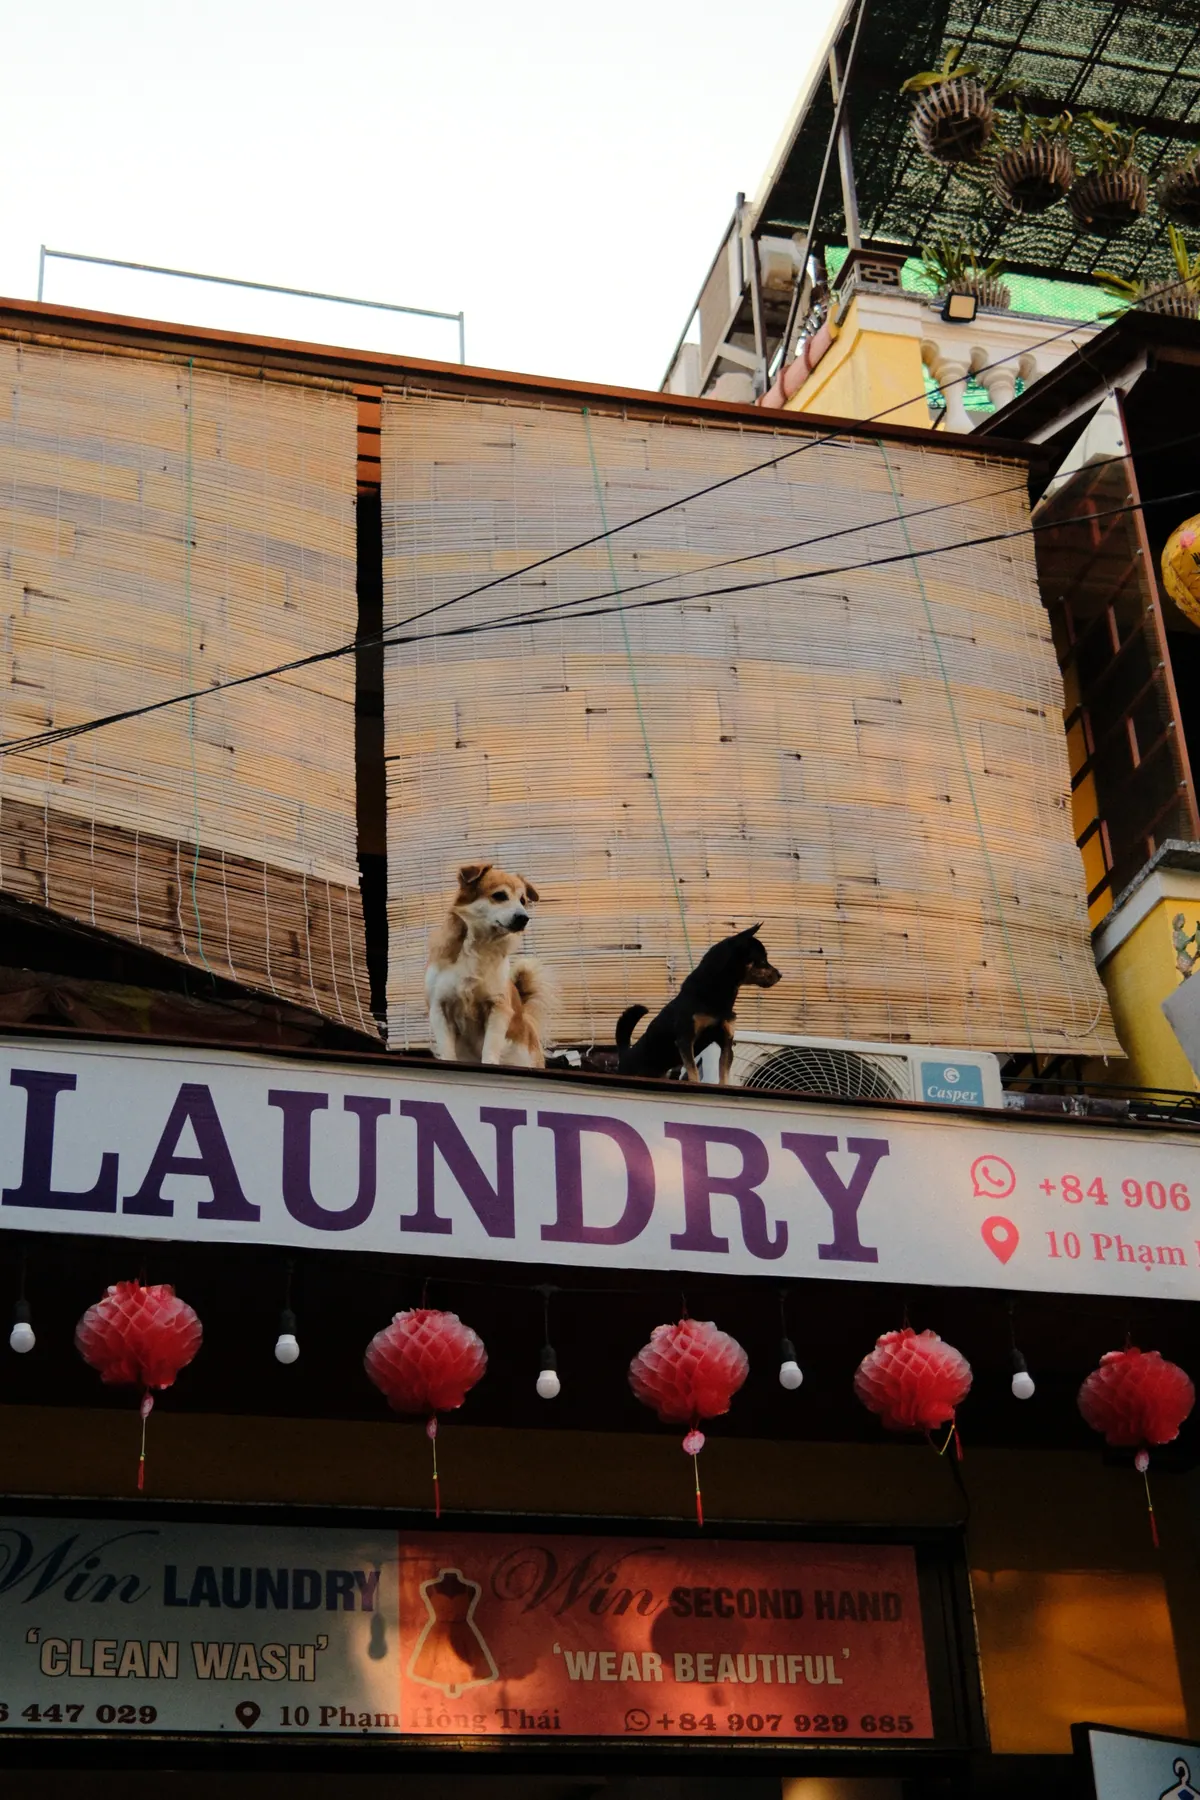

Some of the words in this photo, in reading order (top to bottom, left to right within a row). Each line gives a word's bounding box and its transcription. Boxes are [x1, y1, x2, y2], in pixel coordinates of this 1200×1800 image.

[927, 1086, 978, 1103] Casper
[1, 1068, 890, 1265] LAUNDRY
[1039, 1174, 1108, 1206] +84
[1121, 1178, 1191, 1212] 906
[1045, 1231, 1081, 1259] 10
[1090, 1232, 1188, 1272] Phạm
[0, 1528, 160, 1604] Win
[163, 1564, 381, 1612] LAUNDRY
[490, 1546, 666, 1617] Win
[670, 1586, 804, 1621] SECOND
[814, 1589, 901, 1622] HAND
[21, 1703, 85, 1723] 447
[96, 1704, 158, 1724] 029
[280, 1706, 310, 1727] 10
[319, 1706, 400, 1733] Phạm
[410, 1702, 488, 1733] Hồng
[494, 1707, 562, 1730] Thái
[656, 1712, 717, 1731] +84
[727, 1713, 783, 1732] 907
[793, 1714, 849, 1733] 929
[859, 1714, 914, 1734] 685
